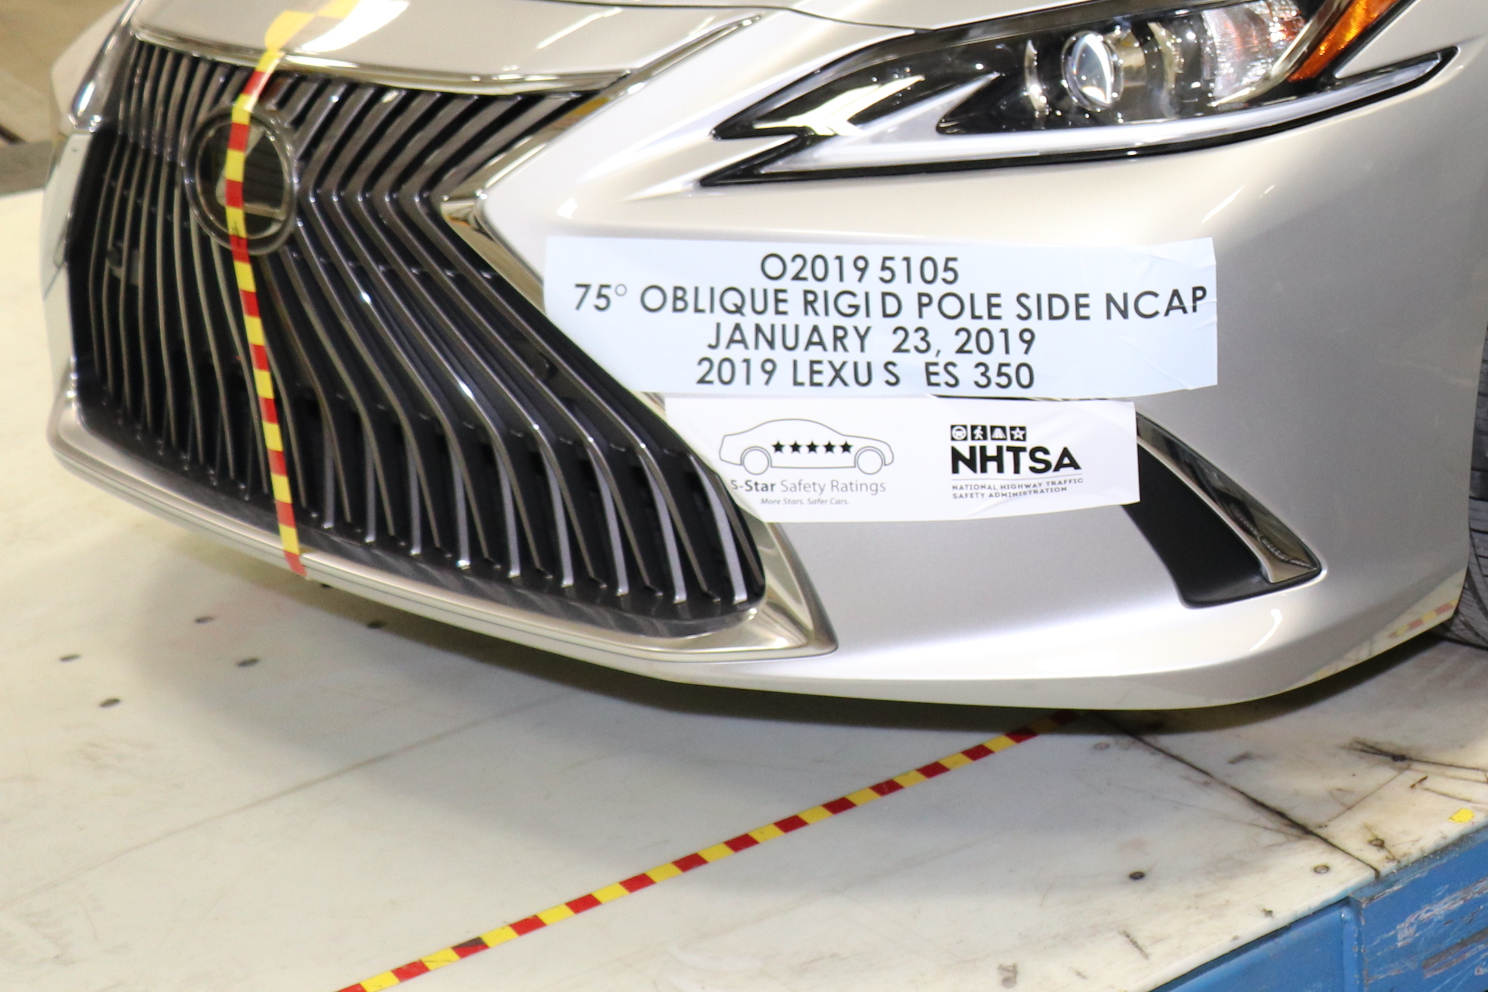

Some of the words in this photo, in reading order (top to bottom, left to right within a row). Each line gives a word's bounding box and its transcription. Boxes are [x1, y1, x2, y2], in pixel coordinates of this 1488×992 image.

[640, 284, 789, 317] OBLIQUE
[803, 289, 903, 319] RIGID
[917, 292, 1003, 321] POLE
[1016, 292, 1091, 321] SIDE
[1106, 285, 1208, 321] NCAP
[707, 322, 872, 353] JANUARY
[892, 325, 942, 358] 23,
[954, 327, 1036, 355] 2019
[696, 356, 778, 386] 2019
[792, 358, 901, 388] LEXUS
[924, 361, 960, 389] ES
[972, 362, 1035, 389] 350
[951, 445, 1082, 475] NHTSA
[730, 479, 777, 492] 5-Star
[780, 479, 826, 495] Safety
[830, 479, 887, 495] Ratings
[988, 486, 1068, 498] ADMINISTRATION
[1000, 482, 1043, 490] HIGHWAY
[1045, 478, 1084, 486] TRAFFIC
[760, 497, 783, 505] More
[783, 497, 806, 505] Stars.
[807, 497, 829, 505] Safer
[829, 497, 850, 505] Cars.
